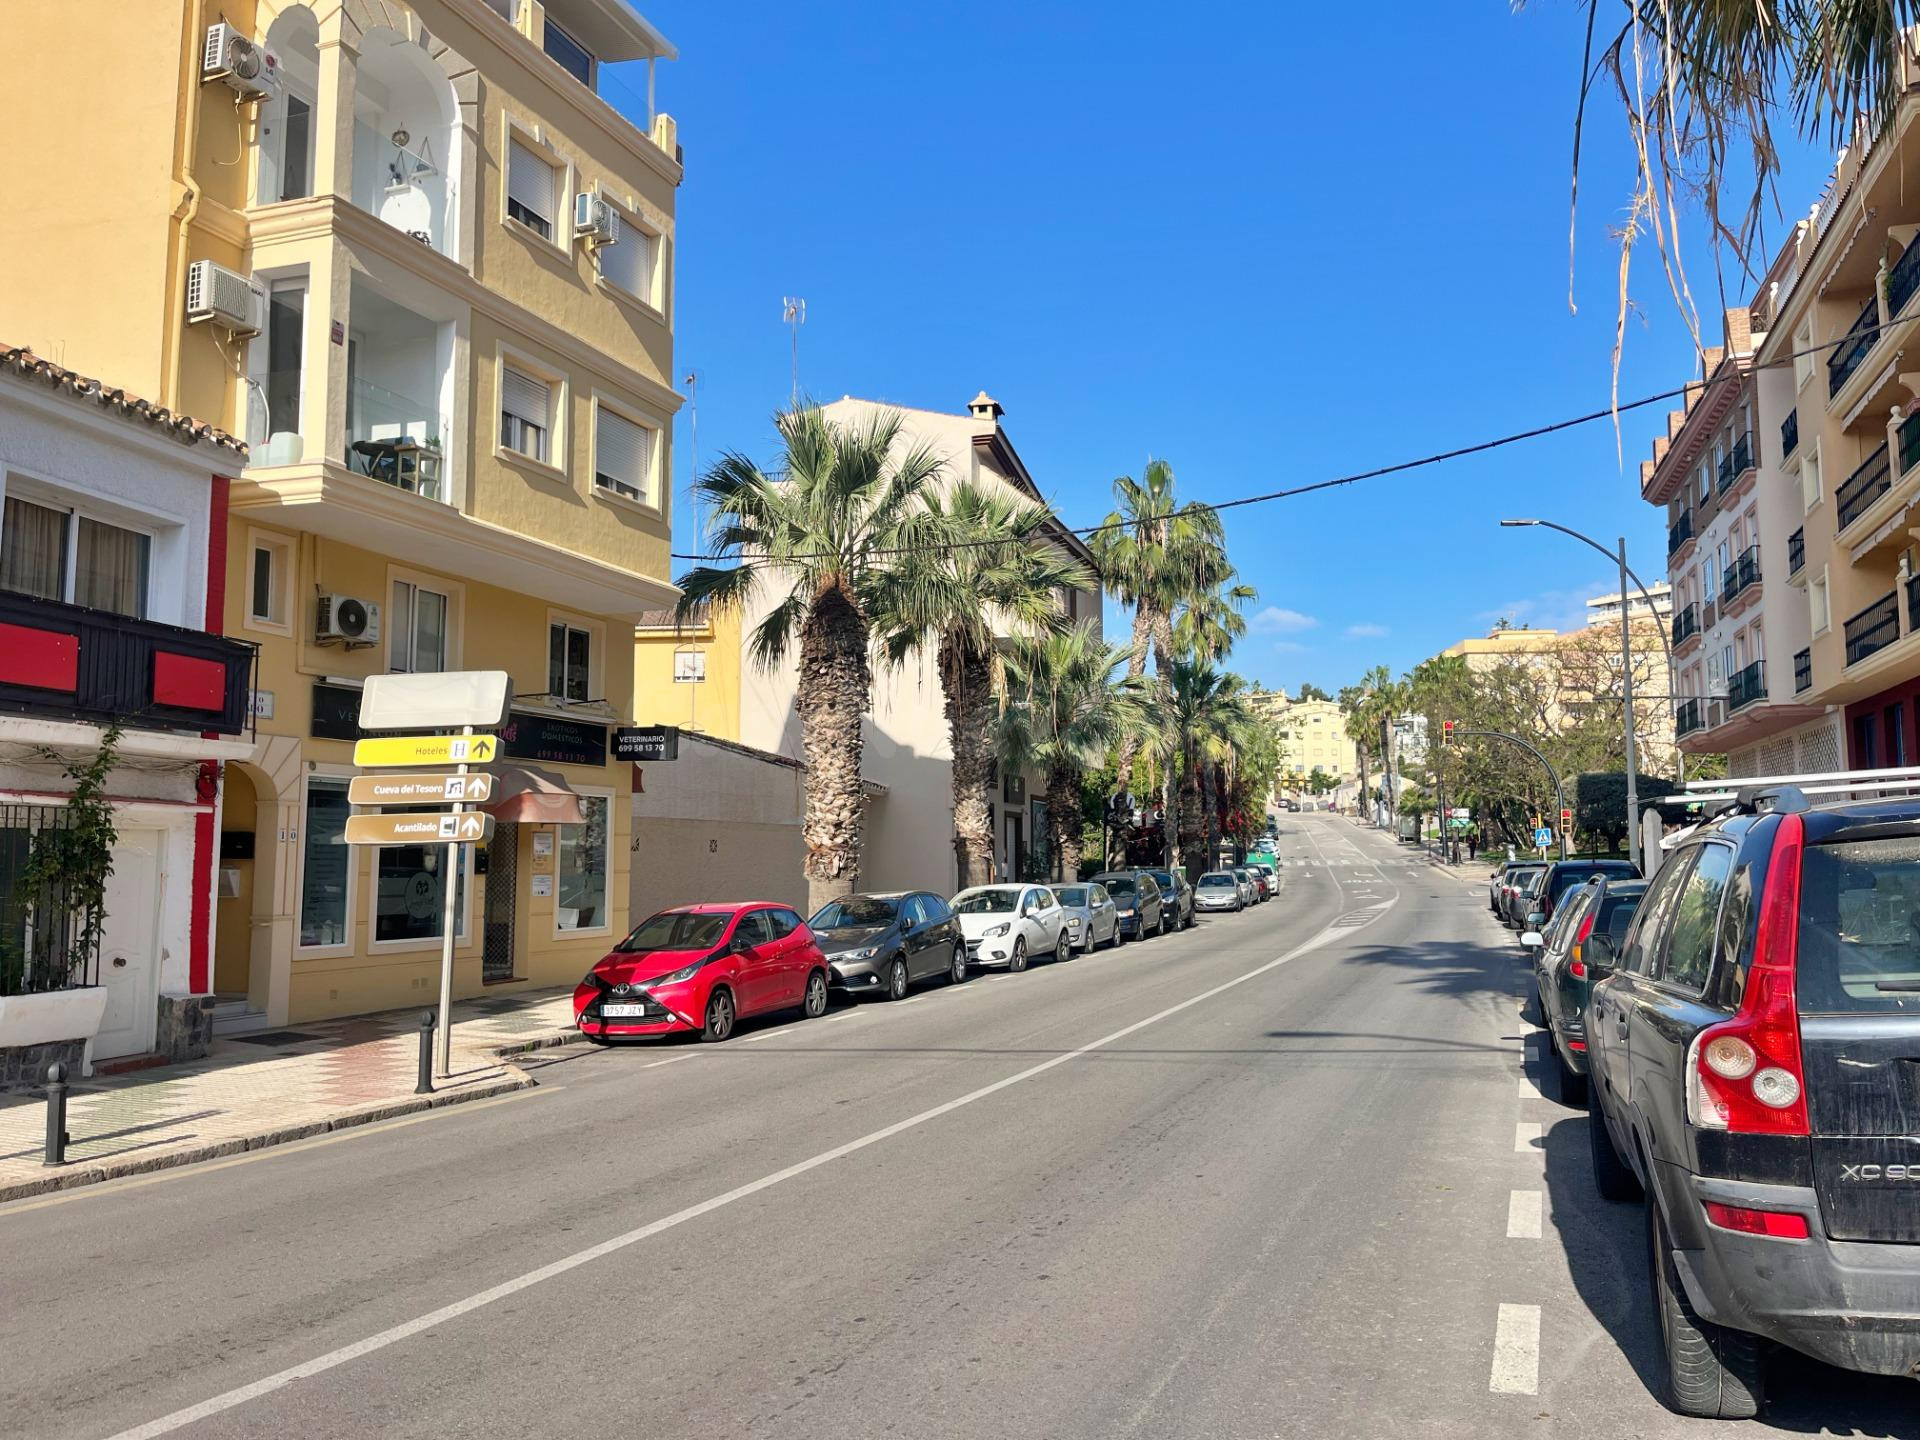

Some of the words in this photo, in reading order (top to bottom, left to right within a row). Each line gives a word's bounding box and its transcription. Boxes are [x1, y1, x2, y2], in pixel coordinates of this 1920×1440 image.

[619, 735, 665, 743] VETERINARIO
[415, 747, 448, 755] Hoteles
[618, 744, 633, 752] 699
[634, 744, 643, 752] 58
[374, 785, 400, 795] Cueva
[400, 784, 414, 794] del
[415, 784, 444, 793] Tesoro
[394, 822, 438, 833] Acantilado
